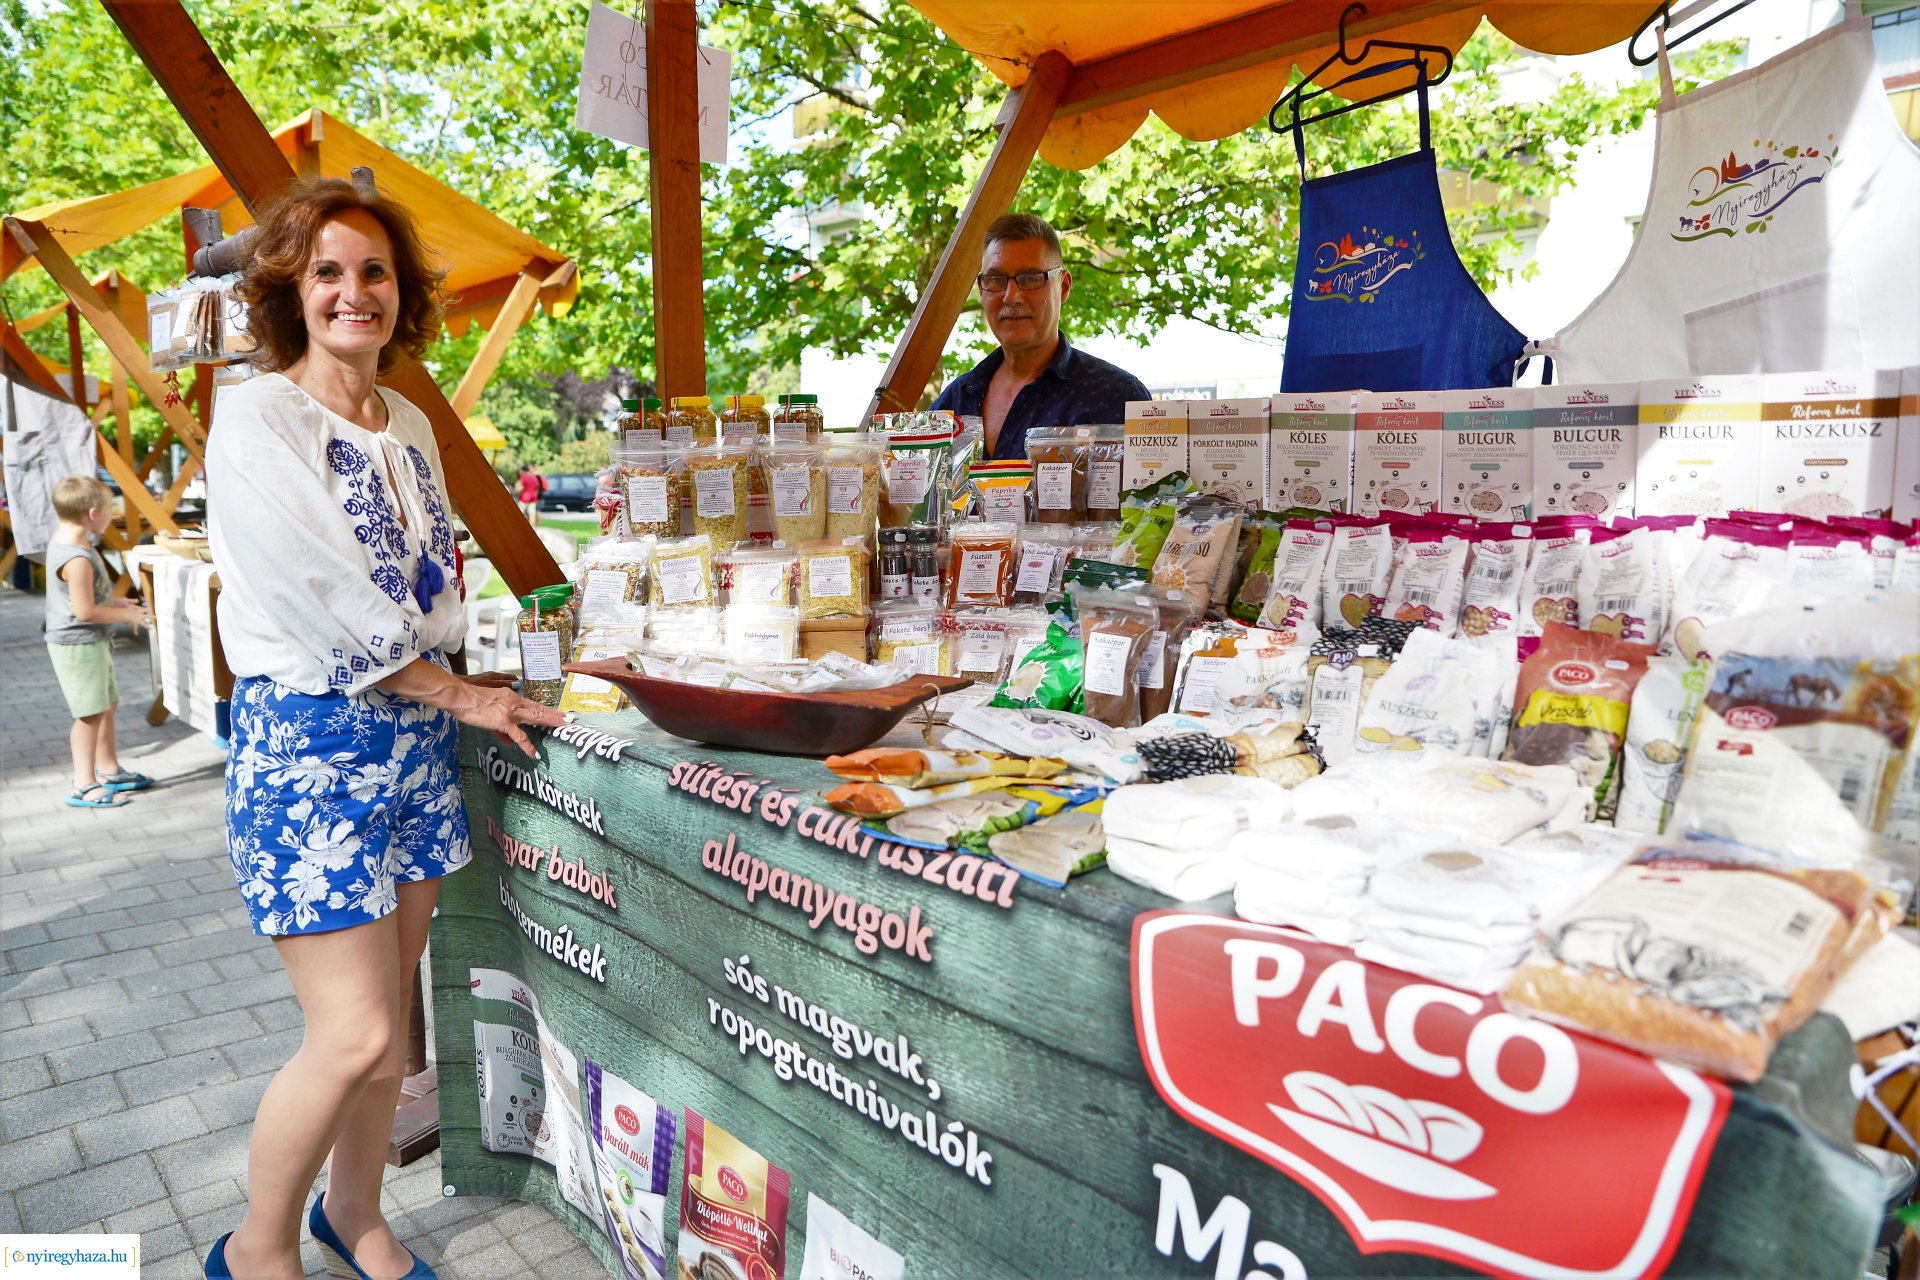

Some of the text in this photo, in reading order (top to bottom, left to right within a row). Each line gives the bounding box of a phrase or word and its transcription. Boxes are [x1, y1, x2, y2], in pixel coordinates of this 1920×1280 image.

[1711, 161, 1807, 226] Nyíregyháza
[1332, 251, 1400, 293] Nyíregyháza
[1567, 394, 1609, 403] VITANESS
[1675, 388, 1721, 398] VITANESS
[1469, 400, 1505, 408] VITANESS
[1560, 411, 1590, 424] Reform
[1790, 402, 1862, 420] Reform köret
[1553, 429, 1623, 442] BULGUR
[1659, 425, 1736, 439] BULGUR
[1776, 422, 1883, 439] KUSZKUSZ
[1129, 436, 1178, 447] KUSZKUSZ
[1290, 431, 1327, 444] KÖLES
[1377, 431, 1418, 444] KÖLES
[1458, 432, 1516, 445] BULGUR
[897, 459, 920, 468] Paprika
[1042, 464, 1068, 473] Kakaópor
[991, 486, 1017, 495] Paprika
[1348, 528, 1382, 538] VITANESS
[1292, 535, 1324, 545] VITANESS
[970, 553, 993, 561] Füstölt
[744, 632, 779, 641] Fokhagyma
[888, 625, 911, 635] Fekete
[970, 632, 1000, 641] Zöld bors
[1558, 668, 1589, 680] PACO
[534, 768, 605, 836] köretek
[547, 845, 618, 909] babok
[701, 832, 934, 963] alapanyagok
[498, 875, 608, 983] biotermékek
[723, 954, 942, 1101] sós magvak,
[1223, 938, 1579, 1114] PACO
[477, 1049, 486, 1099] KÖLES
[707, 997, 993, 1186] ropogtatnivalók
[618, 1111, 637, 1129] PACO
[604, 1126, 629, 1157] Darált
[630, 1152, 650, 1172] mák
[722, 1173, 743, 1195] PACO
